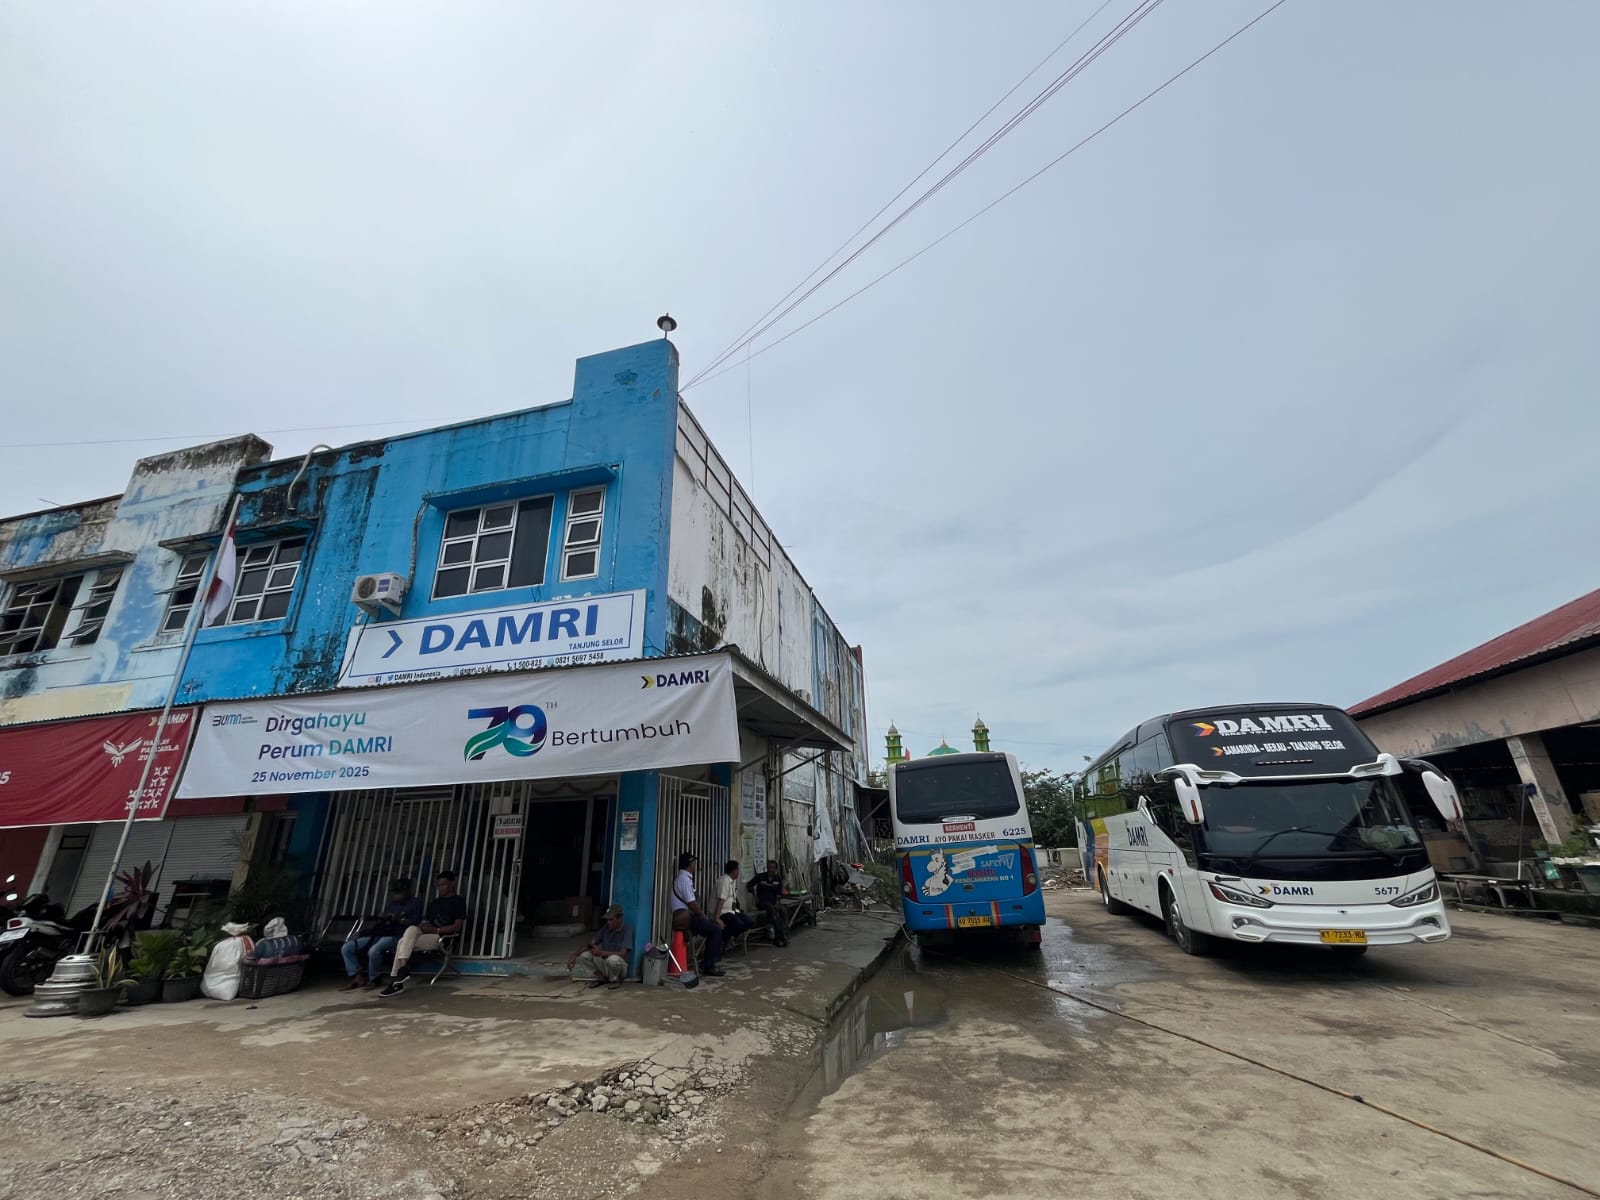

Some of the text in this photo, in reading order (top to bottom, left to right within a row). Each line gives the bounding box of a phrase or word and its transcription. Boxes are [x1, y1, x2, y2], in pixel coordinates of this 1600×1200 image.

[419, 604, 599, 656] DAMRI
[568, 637, 624, 651] TANJUNG SELOR
[555, 656, 570, 665] 0821
[394, 673, 413, 681] DAMRI
[414, 670, 441, 679] Indonesia
[656, 670, 710, 688] DAMRI
[545, 701, 558, 710] TH
[265, 711, 366, 736] Dirgahayu
[1212, 714, 1332, 734] DAMRI
[551, 719, 691, 747] Bertumbuh
[258, 735, 393, 760] Perum DAMRI
[1222, 743, 1261, 756] SAMARINDA
[1263, 742, 1287, 753] BERAU
[1289, 741, 1323, 751] TANJUNG
[1321, 740, 1345, 750] SELOR
[0, 771, 12, 785] 5
[251, 766, 370, 783] 25 November 2025
[935, 832, 996, 844] AYO PAKAI MASKER
[1002, 827, 1027, 837] 6225
[1126, 826, 1149, 847] DAMRI
[897, 835, 930, 845] DAMRI
[1273, 886, 1314, 896] DAMRI
[1374, 887, 1399, 895] 5677
